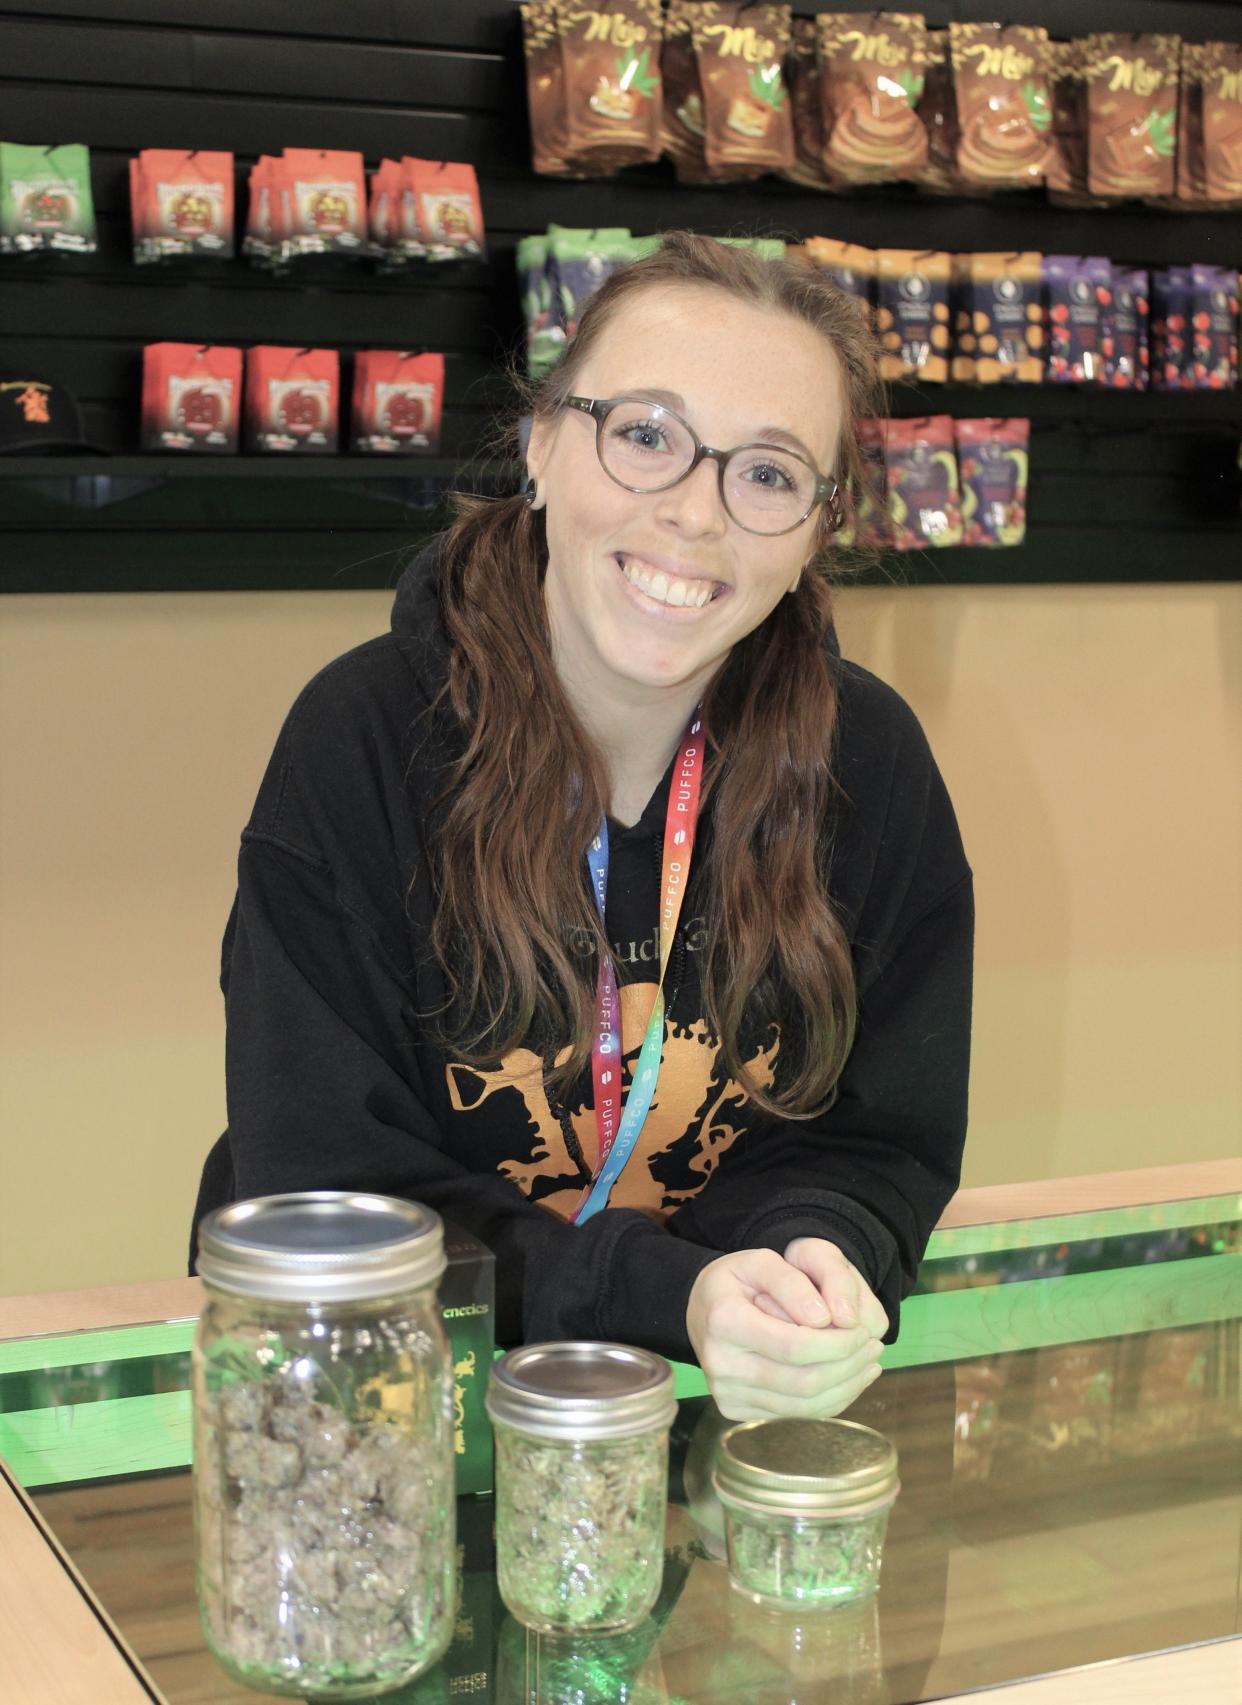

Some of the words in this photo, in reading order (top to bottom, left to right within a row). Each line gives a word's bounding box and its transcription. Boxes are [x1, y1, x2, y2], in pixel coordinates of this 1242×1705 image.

[677, 748, 697, 812] PUFFCO
[662, 861, 682, 931] PUFFCO
[599, 985, 613, 1054] PUFFCO
[615, 1097, 646, 1157] PUFFCO
